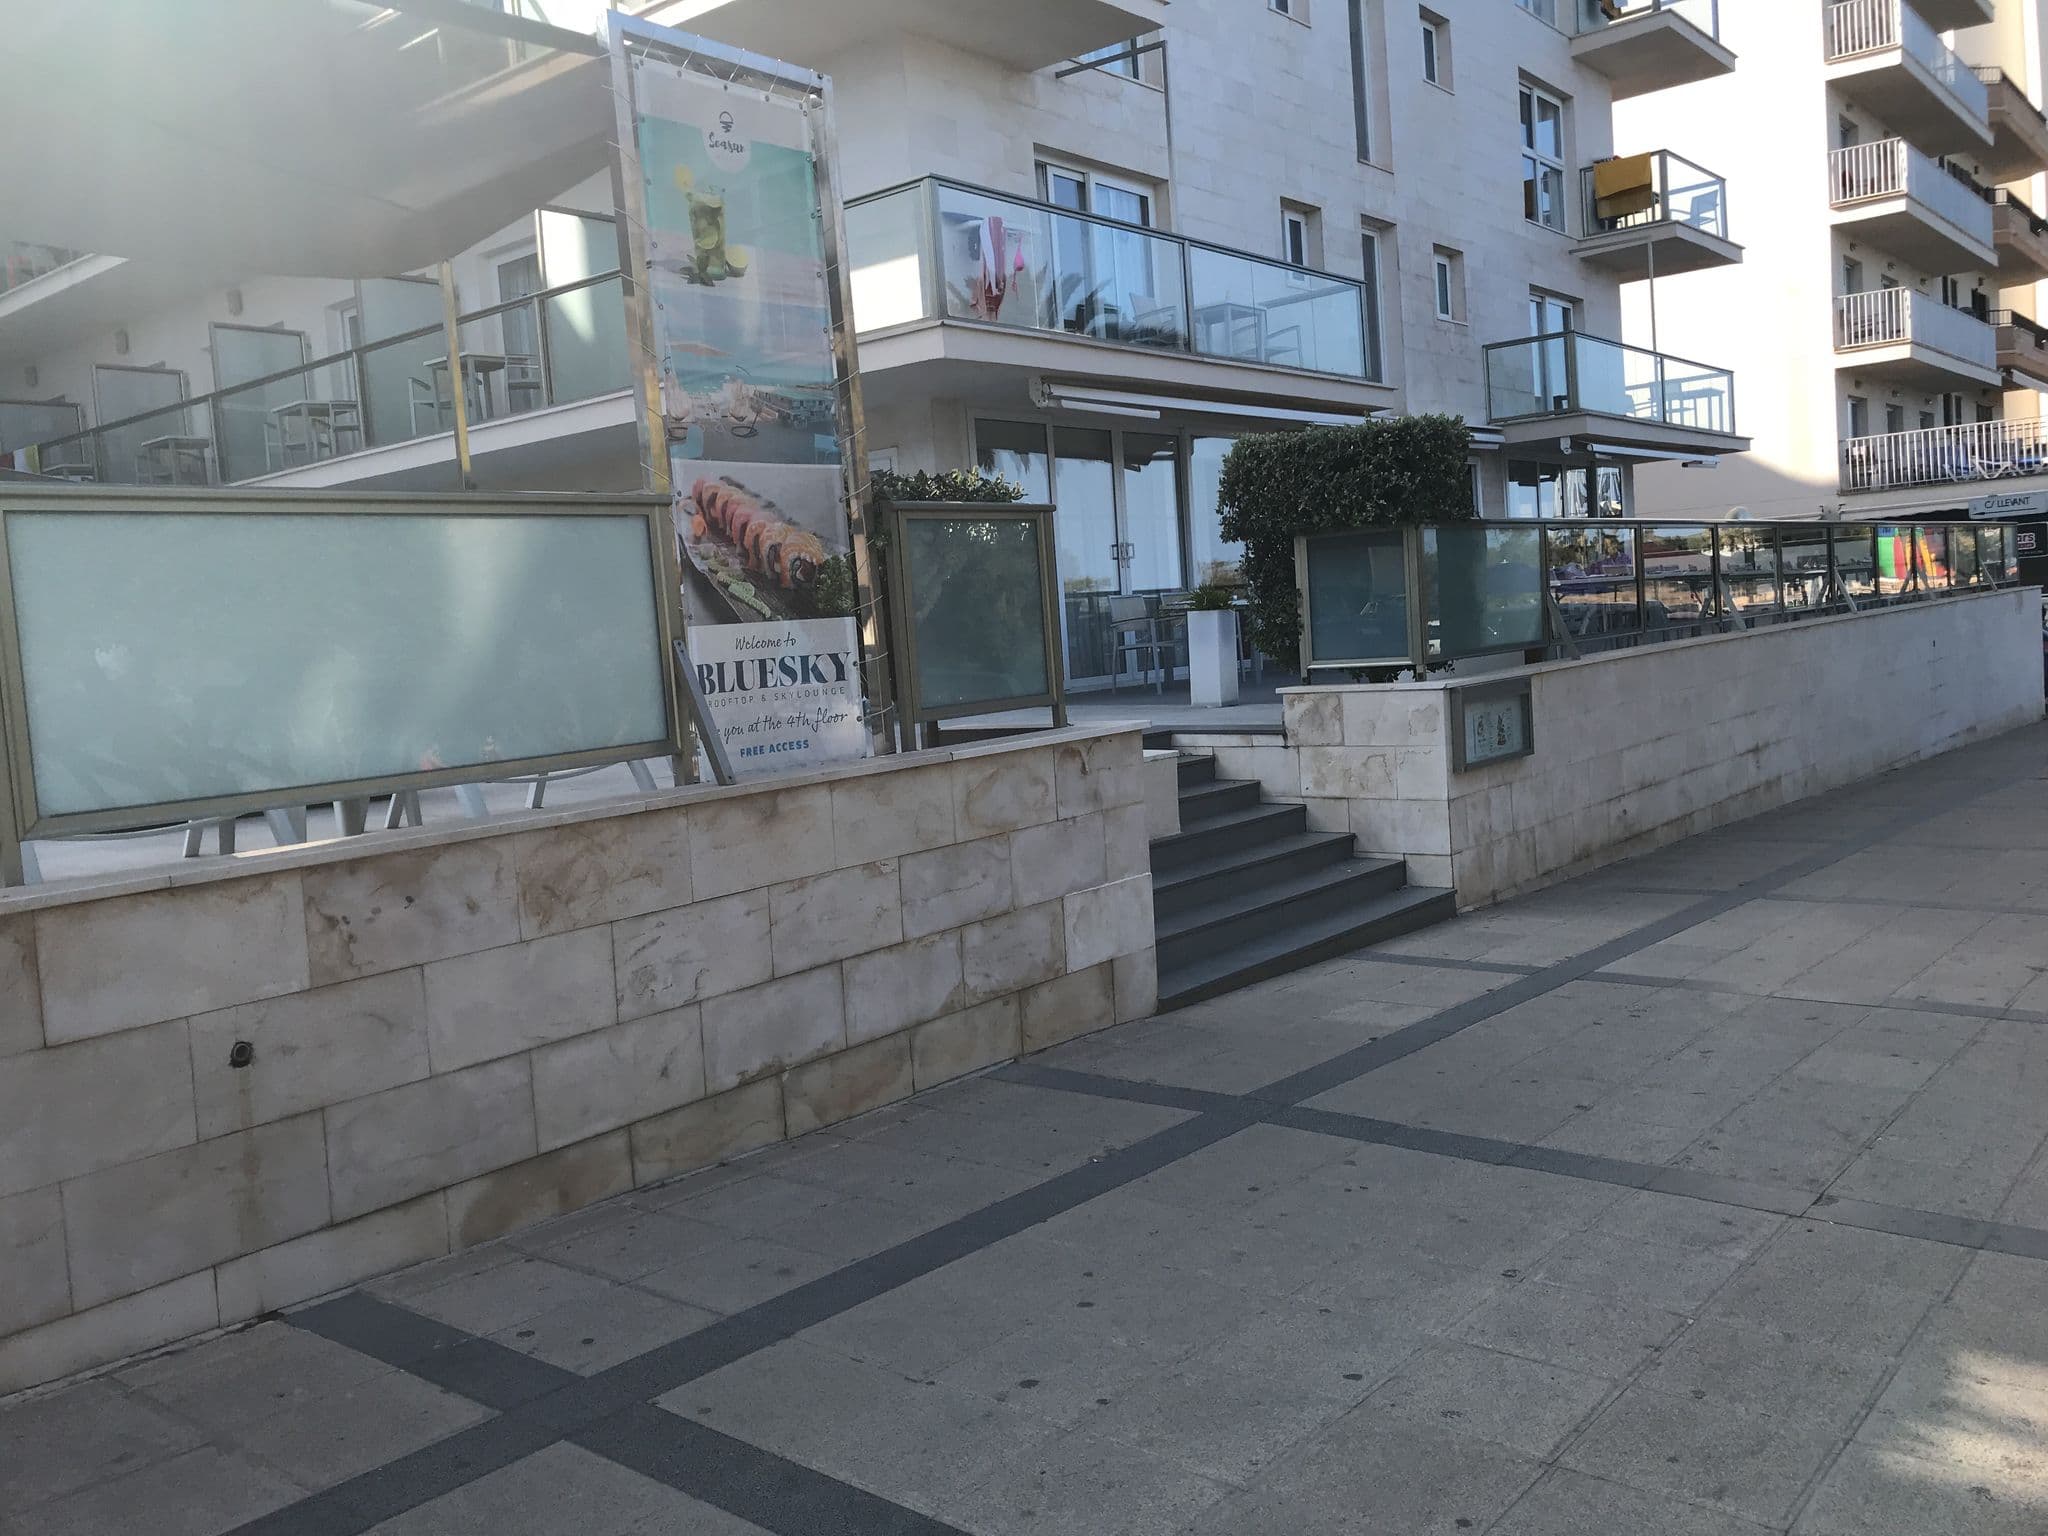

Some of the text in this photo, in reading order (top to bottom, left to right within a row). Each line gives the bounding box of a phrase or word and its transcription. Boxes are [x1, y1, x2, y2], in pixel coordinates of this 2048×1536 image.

[1984, 496, 2031, 509] C/ LLEVANT
[735, 631, 797, 650] Welcome to
[696, 652, 852, 695] BLUESKY
[774, 686, 845, 701] SKYLOUNGE
[723, 726, 745, 745] you
[747, 715, 761, 733] at
[762, 715, 782, 732] the
[786, 711, 811, 728] 4th
[811, 706, 849, 733] floor
[740, 739, 809, 758] FREE ACCESS
